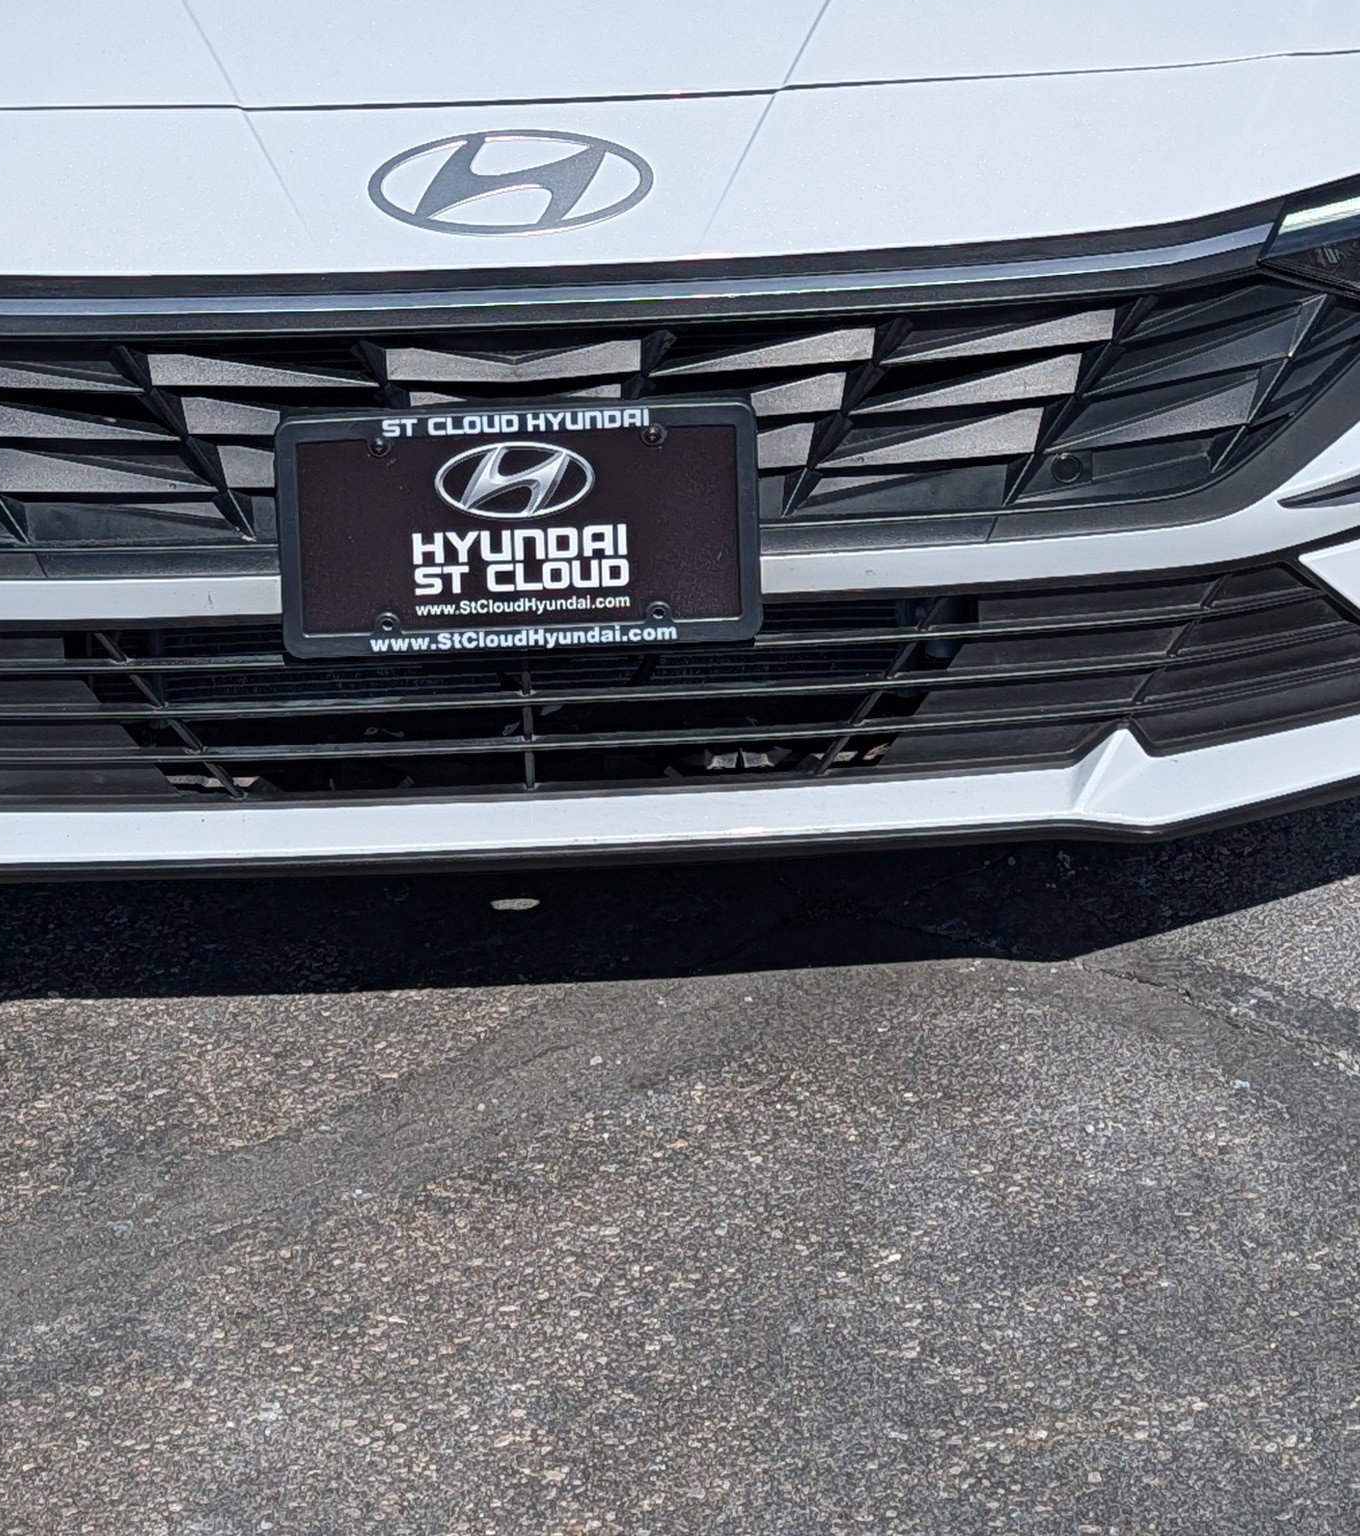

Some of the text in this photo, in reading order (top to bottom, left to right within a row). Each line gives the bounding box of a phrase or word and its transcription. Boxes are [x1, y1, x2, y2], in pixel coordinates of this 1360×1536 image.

[382, 408, 651, 438] ST CLOUD HYUNDAI
[411, 524, 628, 565] HYUNDAI
[414, 558, 630, 596] ST CLOUD
[415, 595, 631, 616] www.StCloudHyundai.com
[370, 623, 678, 653] www.StCloudHyundai.com
